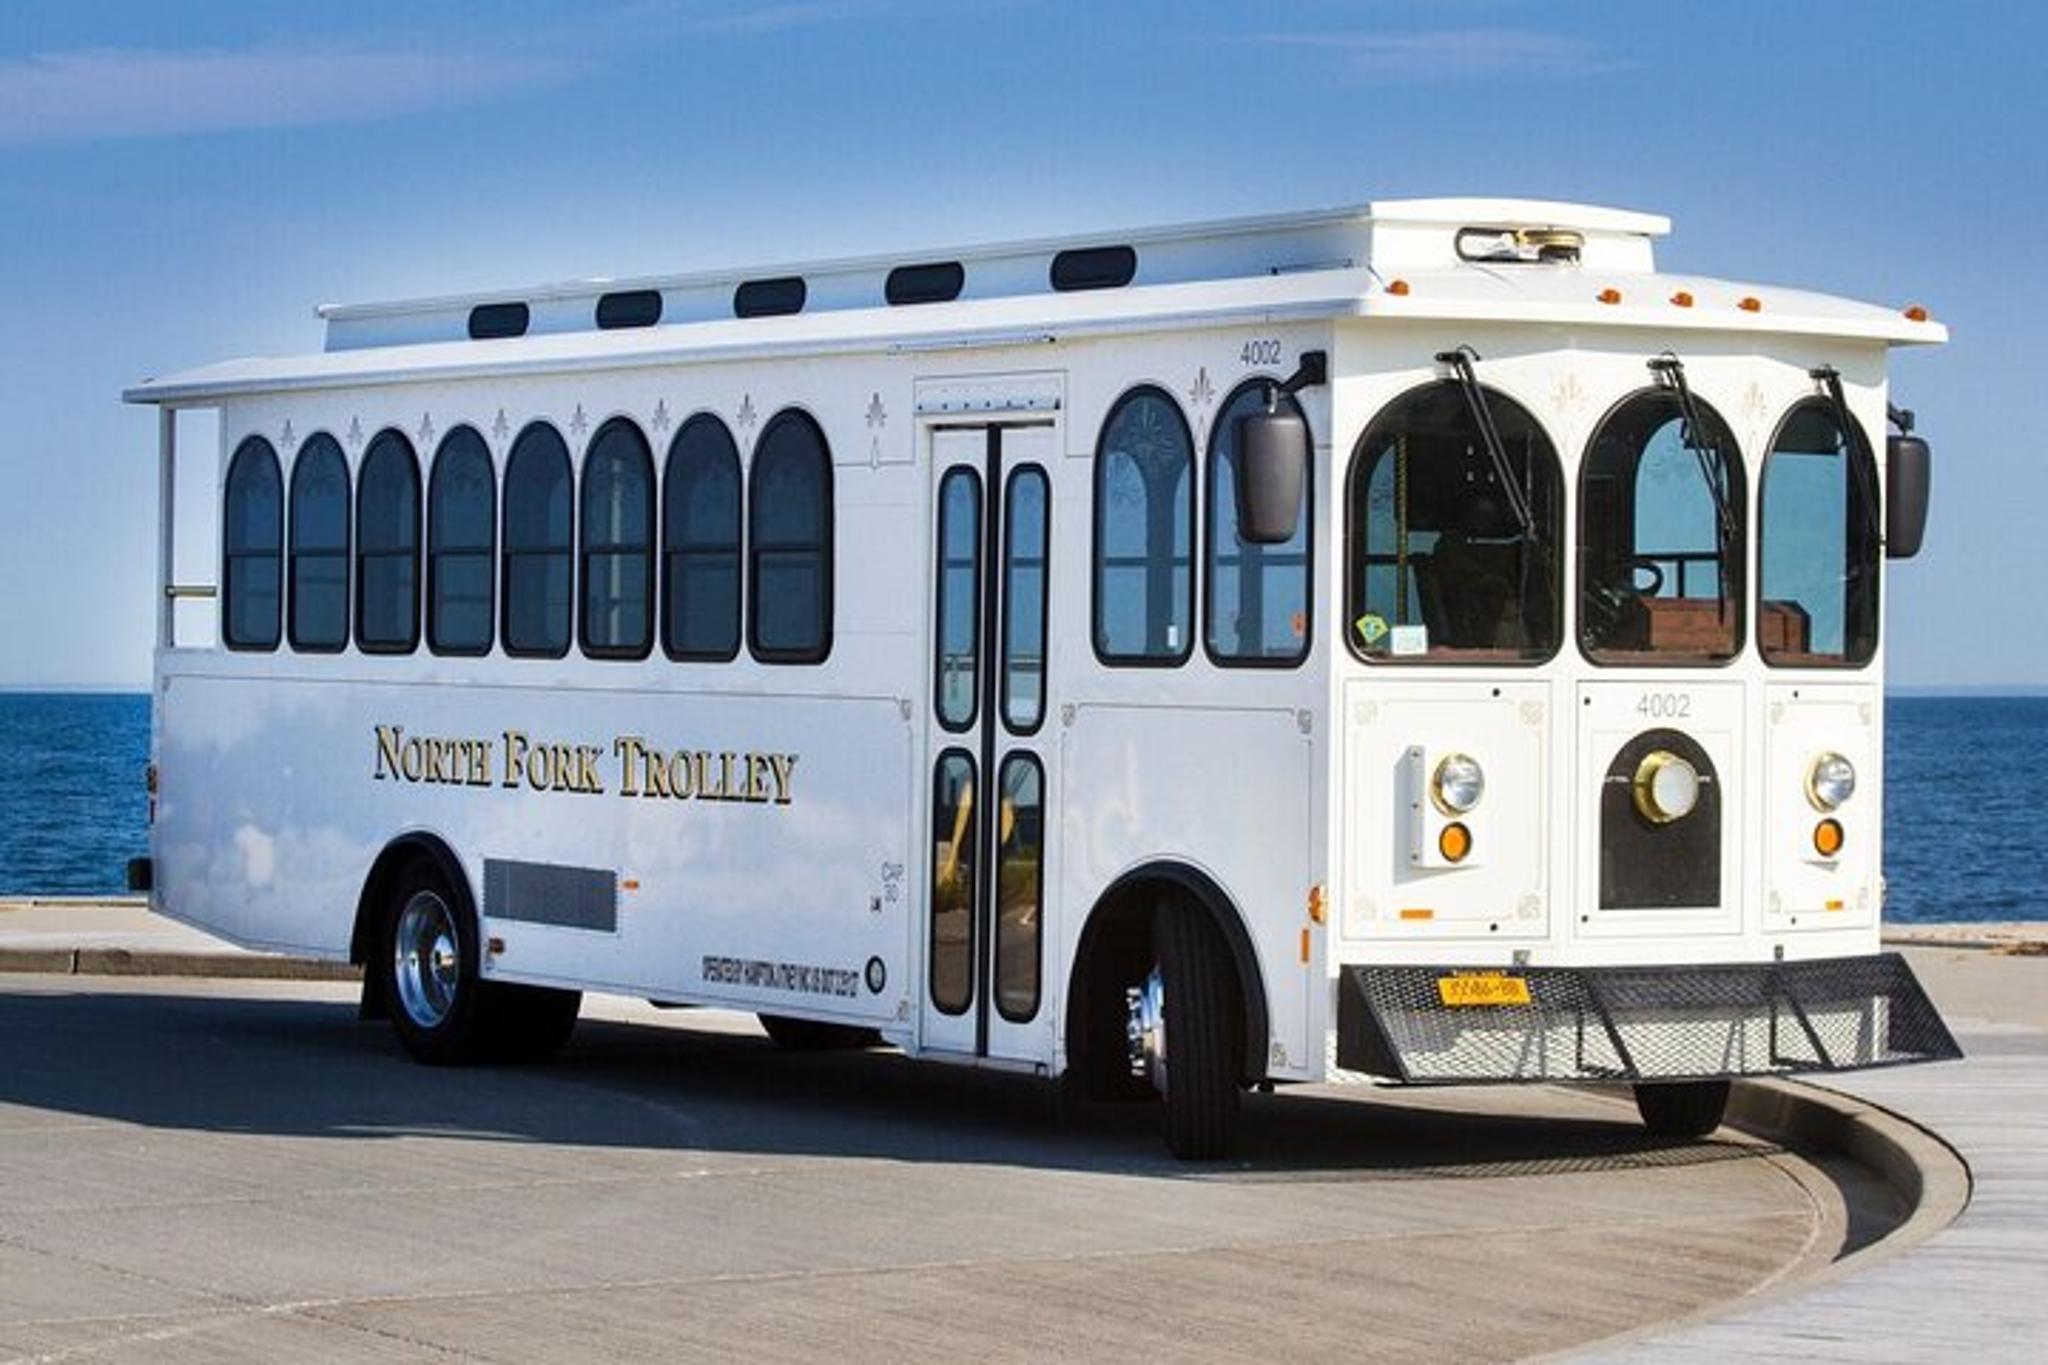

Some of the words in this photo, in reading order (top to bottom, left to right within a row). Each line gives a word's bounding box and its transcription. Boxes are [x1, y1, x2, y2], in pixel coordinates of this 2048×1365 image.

[1240, 340, 1281, 366] 4002
[1637, 693, 1691, 717] 4002
[373, 724, 492, 786] NORTH
[502, 728, 605, 796] FORK
[614, 735, 799, 805] TROLLEY
